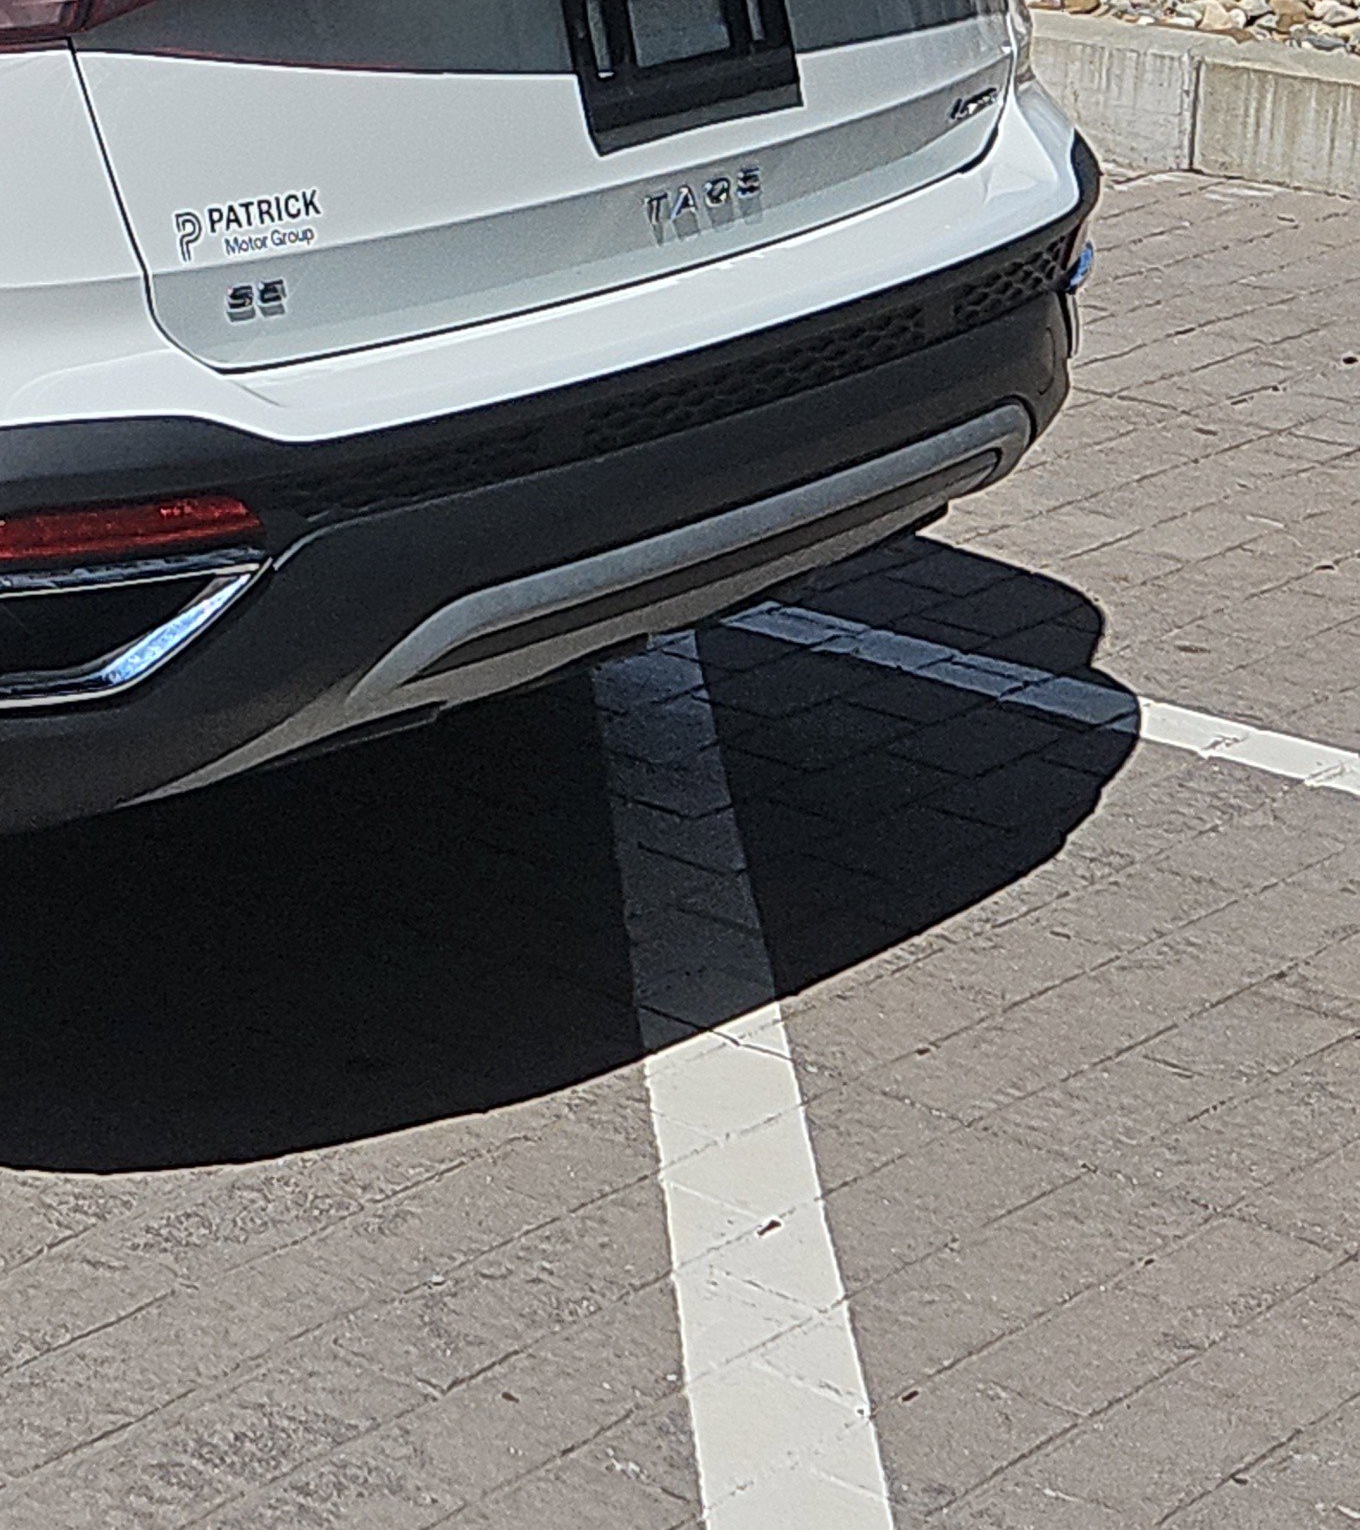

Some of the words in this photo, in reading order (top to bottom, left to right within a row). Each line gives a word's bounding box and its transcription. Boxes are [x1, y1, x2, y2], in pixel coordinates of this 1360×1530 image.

[207, 189, 322, 234] PATRICK
[224, 235, 269, 256] Motor
[270, 227, 316, 248] Group
[227, 279, 288, 311] SE
